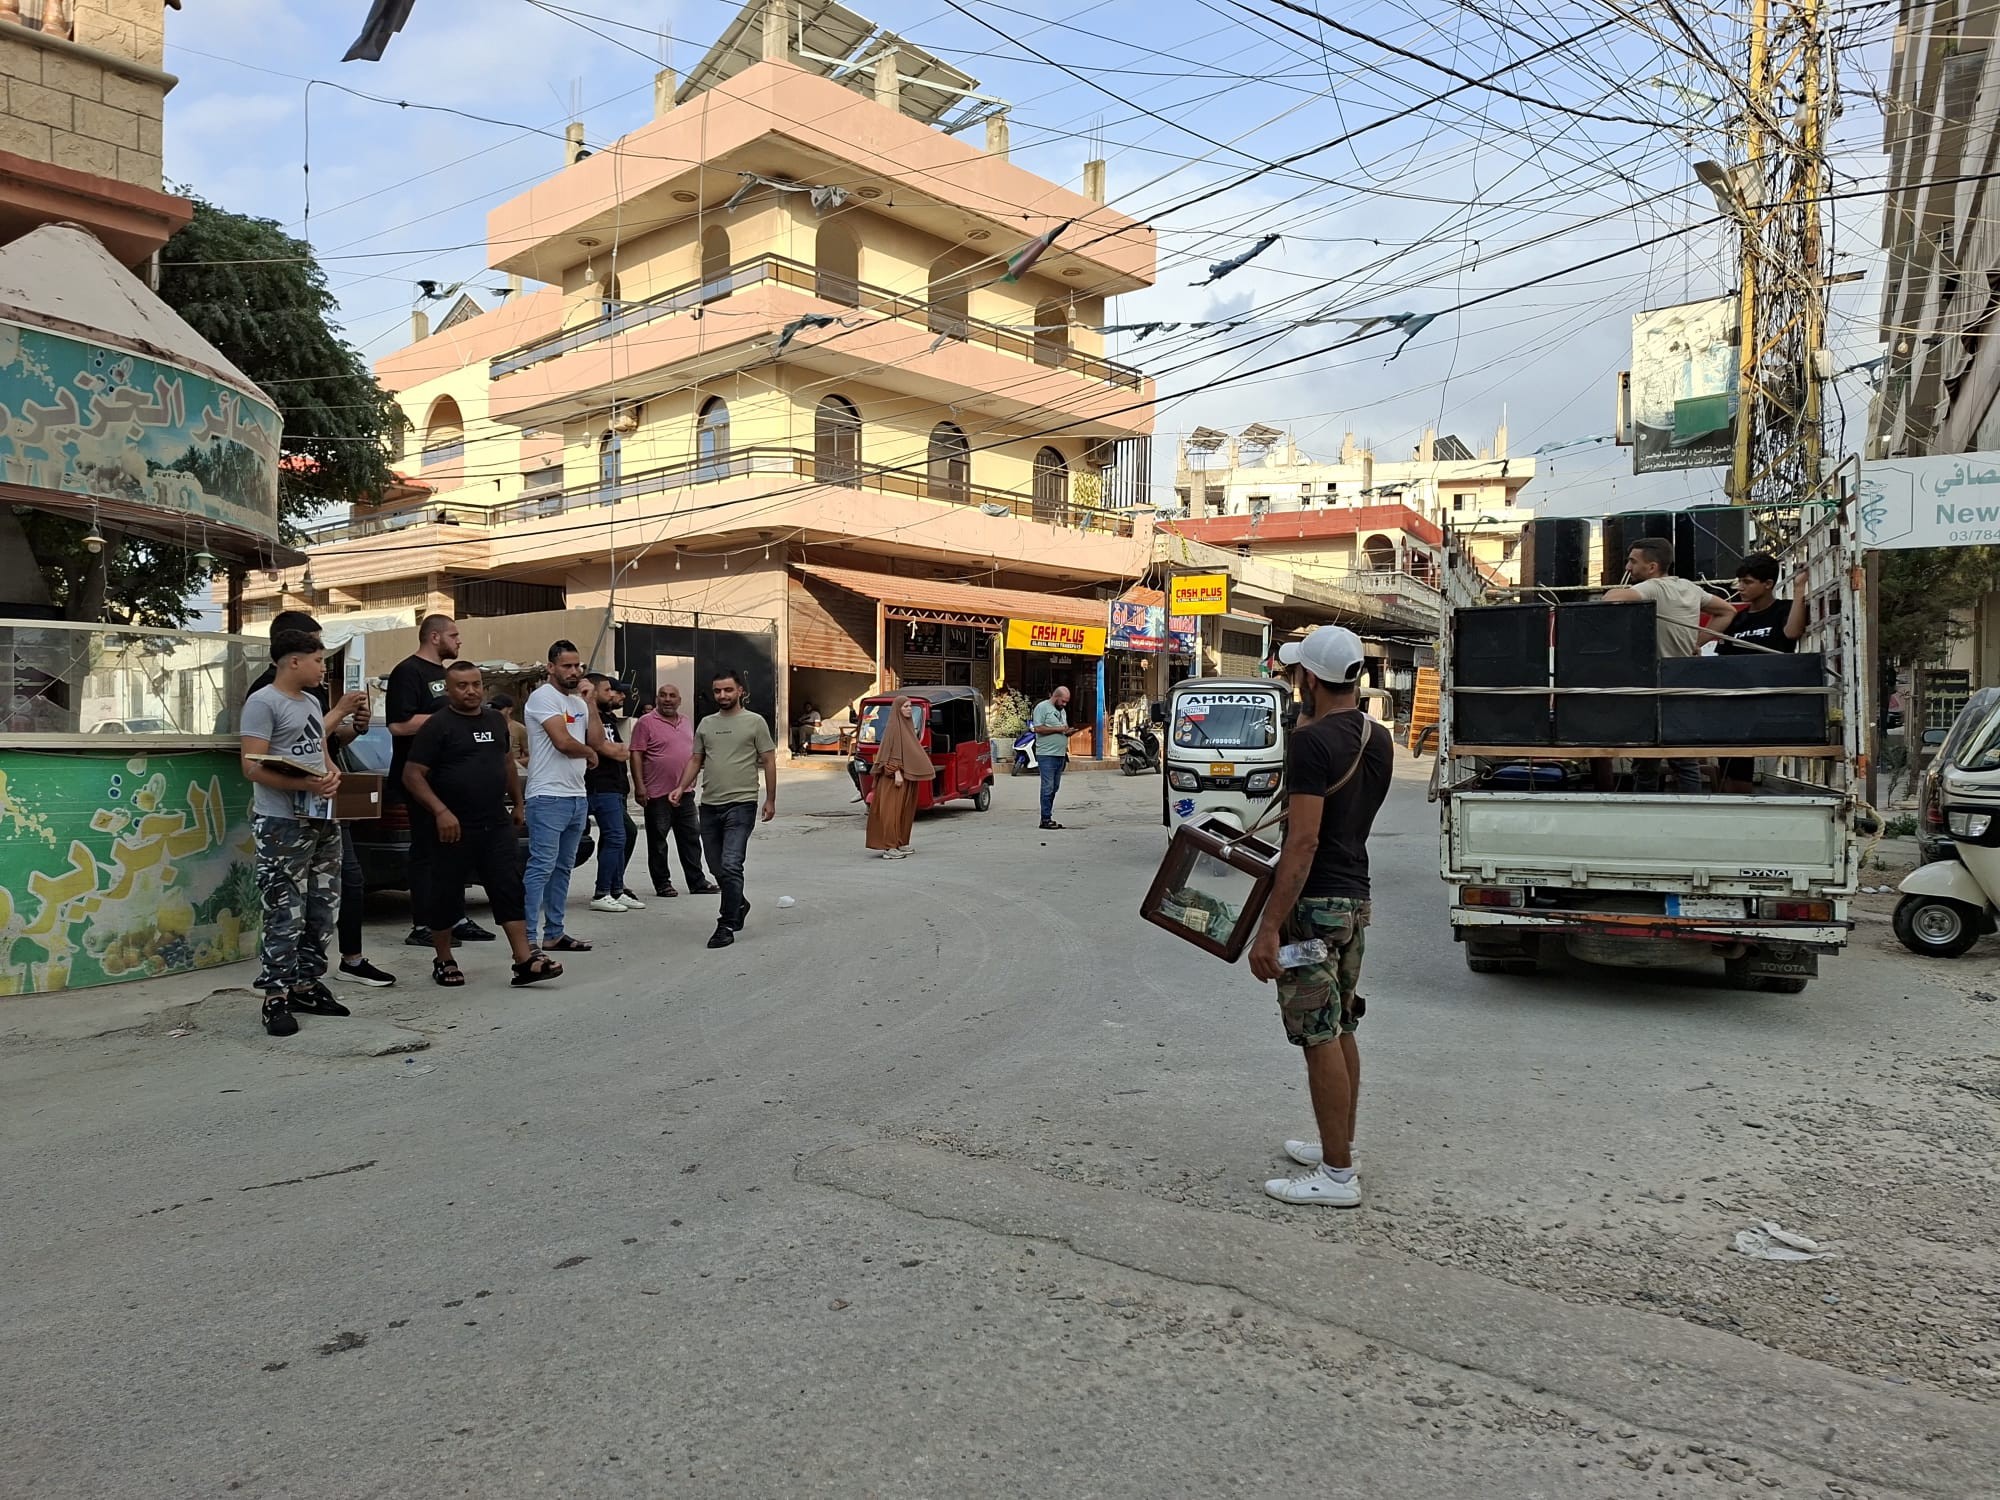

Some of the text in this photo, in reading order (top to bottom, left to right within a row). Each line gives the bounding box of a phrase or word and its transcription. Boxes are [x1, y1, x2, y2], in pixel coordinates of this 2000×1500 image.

[1667, 460, 1687, 468] محمود
[1936, 504, 2000, 525] New
[1176, 587, 1222, 599] CASH PLUS
[1031, 625, 1085, 643] CASH PLUS
[1187, 695, 1267, 705] AHMAD
[473, 731, 494, 742] EA7
[1741, 869, 1788, 877] DYNA
[1760, 962, 1807, 972] TOYOTA
